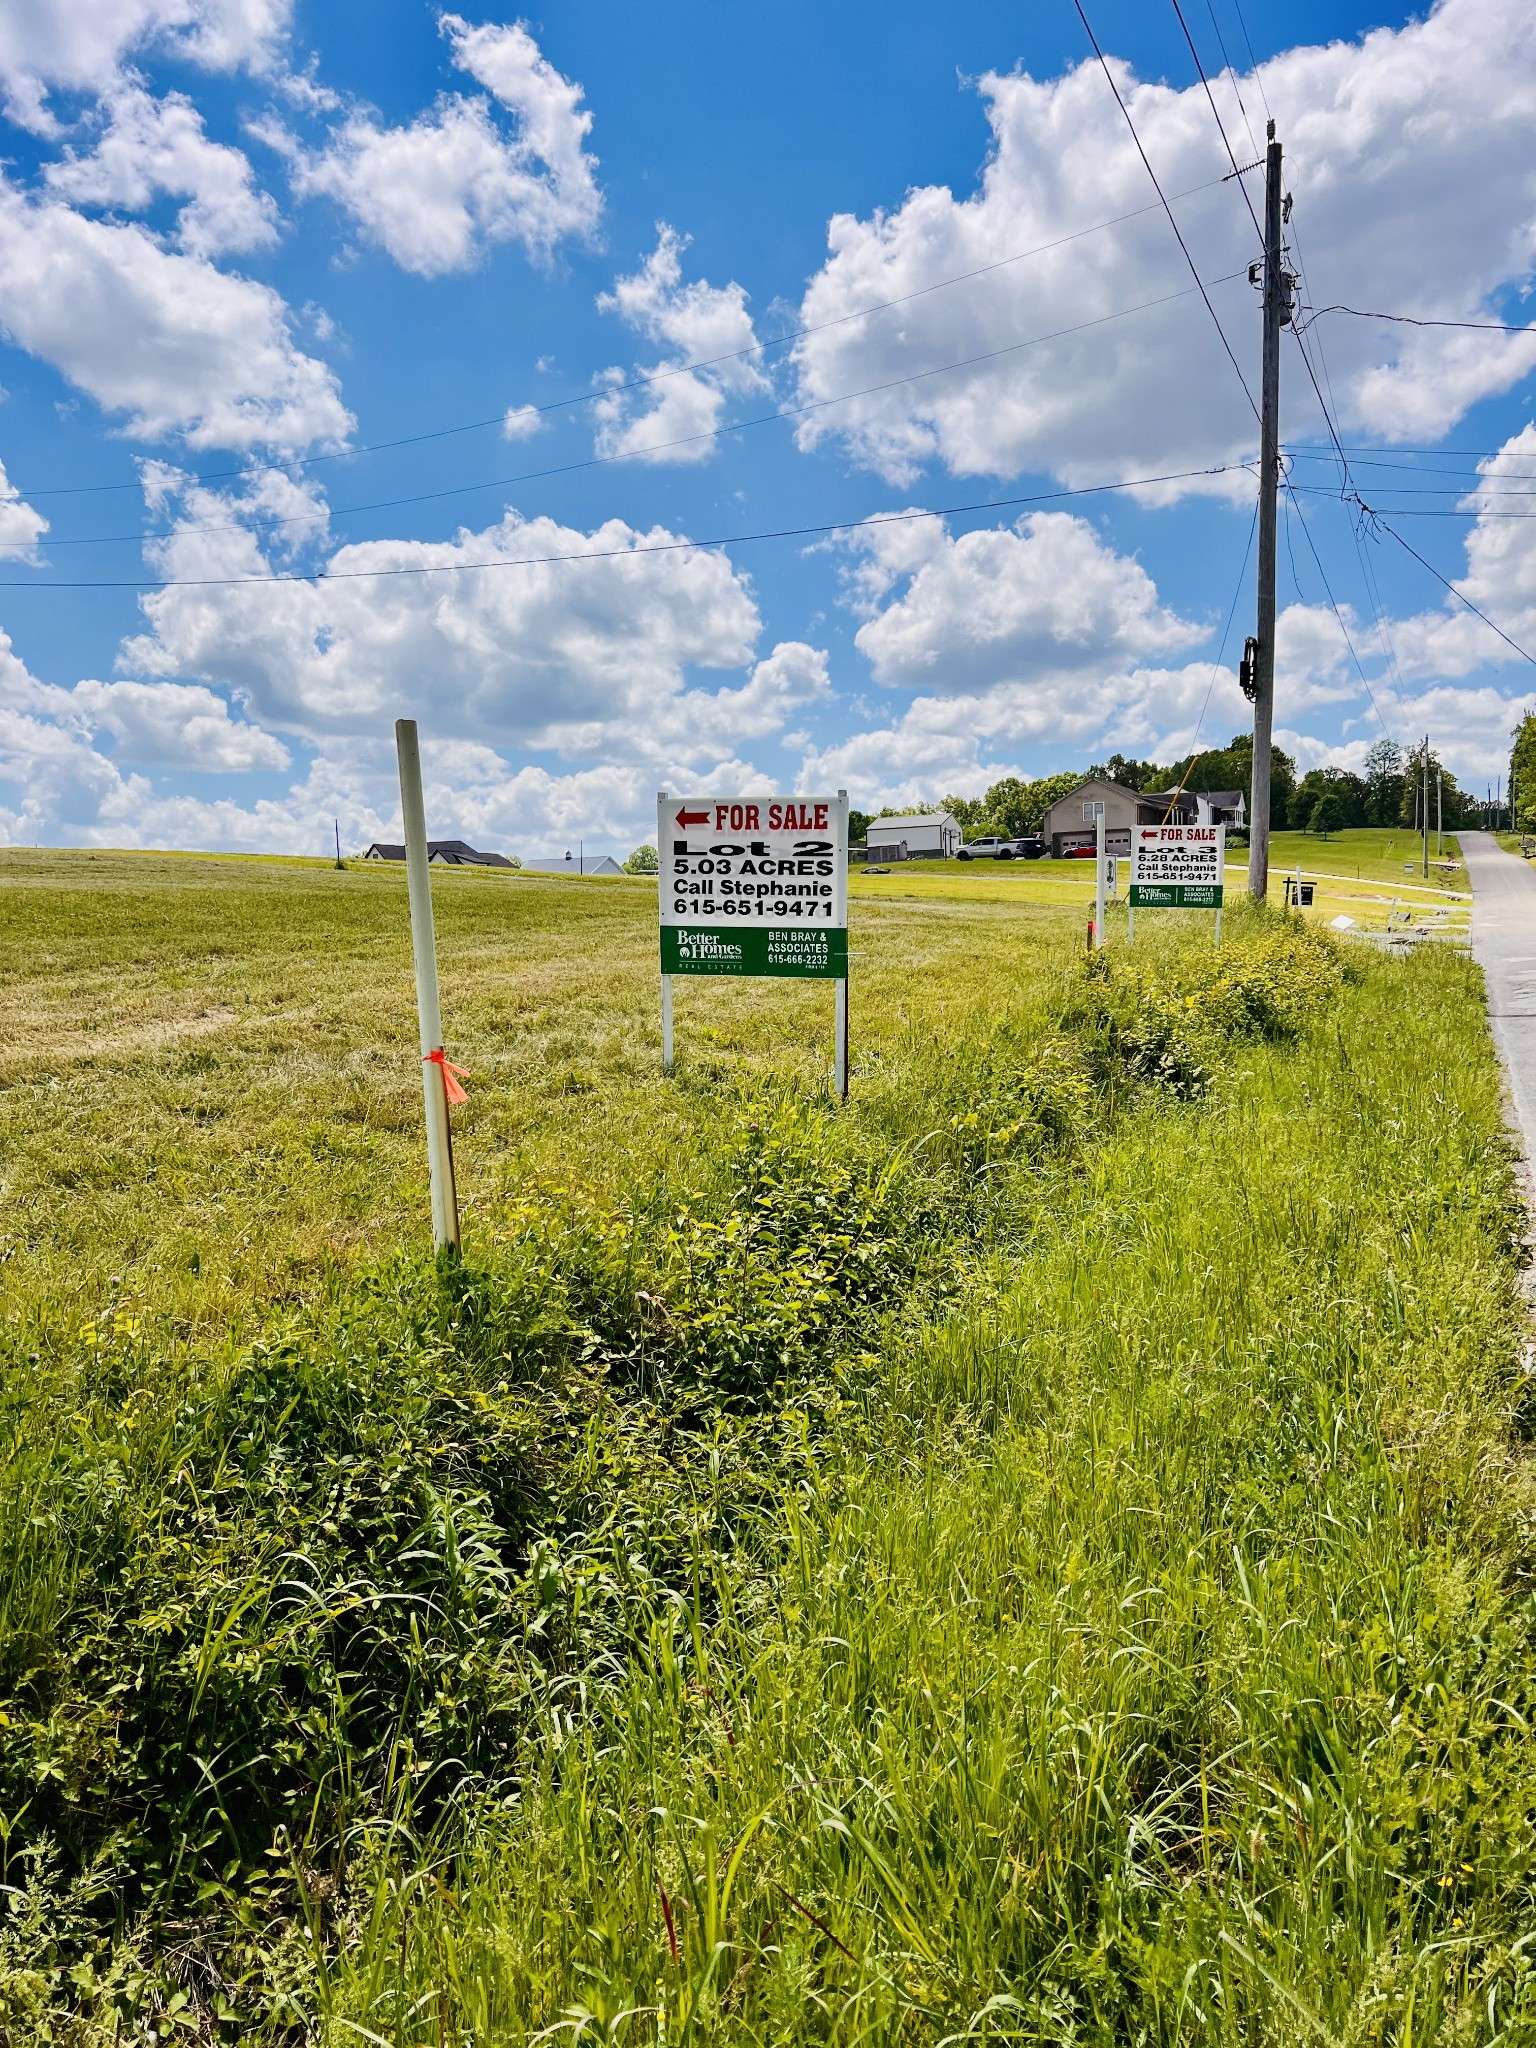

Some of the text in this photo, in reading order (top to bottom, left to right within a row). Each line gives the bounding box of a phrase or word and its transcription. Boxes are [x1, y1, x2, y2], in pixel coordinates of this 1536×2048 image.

[716, 804, 829, 831] FOR SALE
[1160, 828, 1217, 841] FOR SALE
[673, 840, 834, 857] Lot 2
[1138, 846, 1218, 854] Lot 3
[1138, 854, 1218, 862] 6.28 ACRES
[673, 859, 834, 876] 5.03 ACRES
[1137, 863, 1217, 873] Call Stephanie
[1137, 872, 1217, 881] 615-651-9471
[673, 878, 833, 899] Call Stephanie
[673, 898, 833, 917] 615-651-9471
[676, 929, 720, 945] Better
[768, 931, 827, 942] BEN BRAY &
[691, 944, 742, 959] Homes
[767, 942, 829, 953] ASSOCIATES
[767, 953, 828, 965] 615-666-2232
